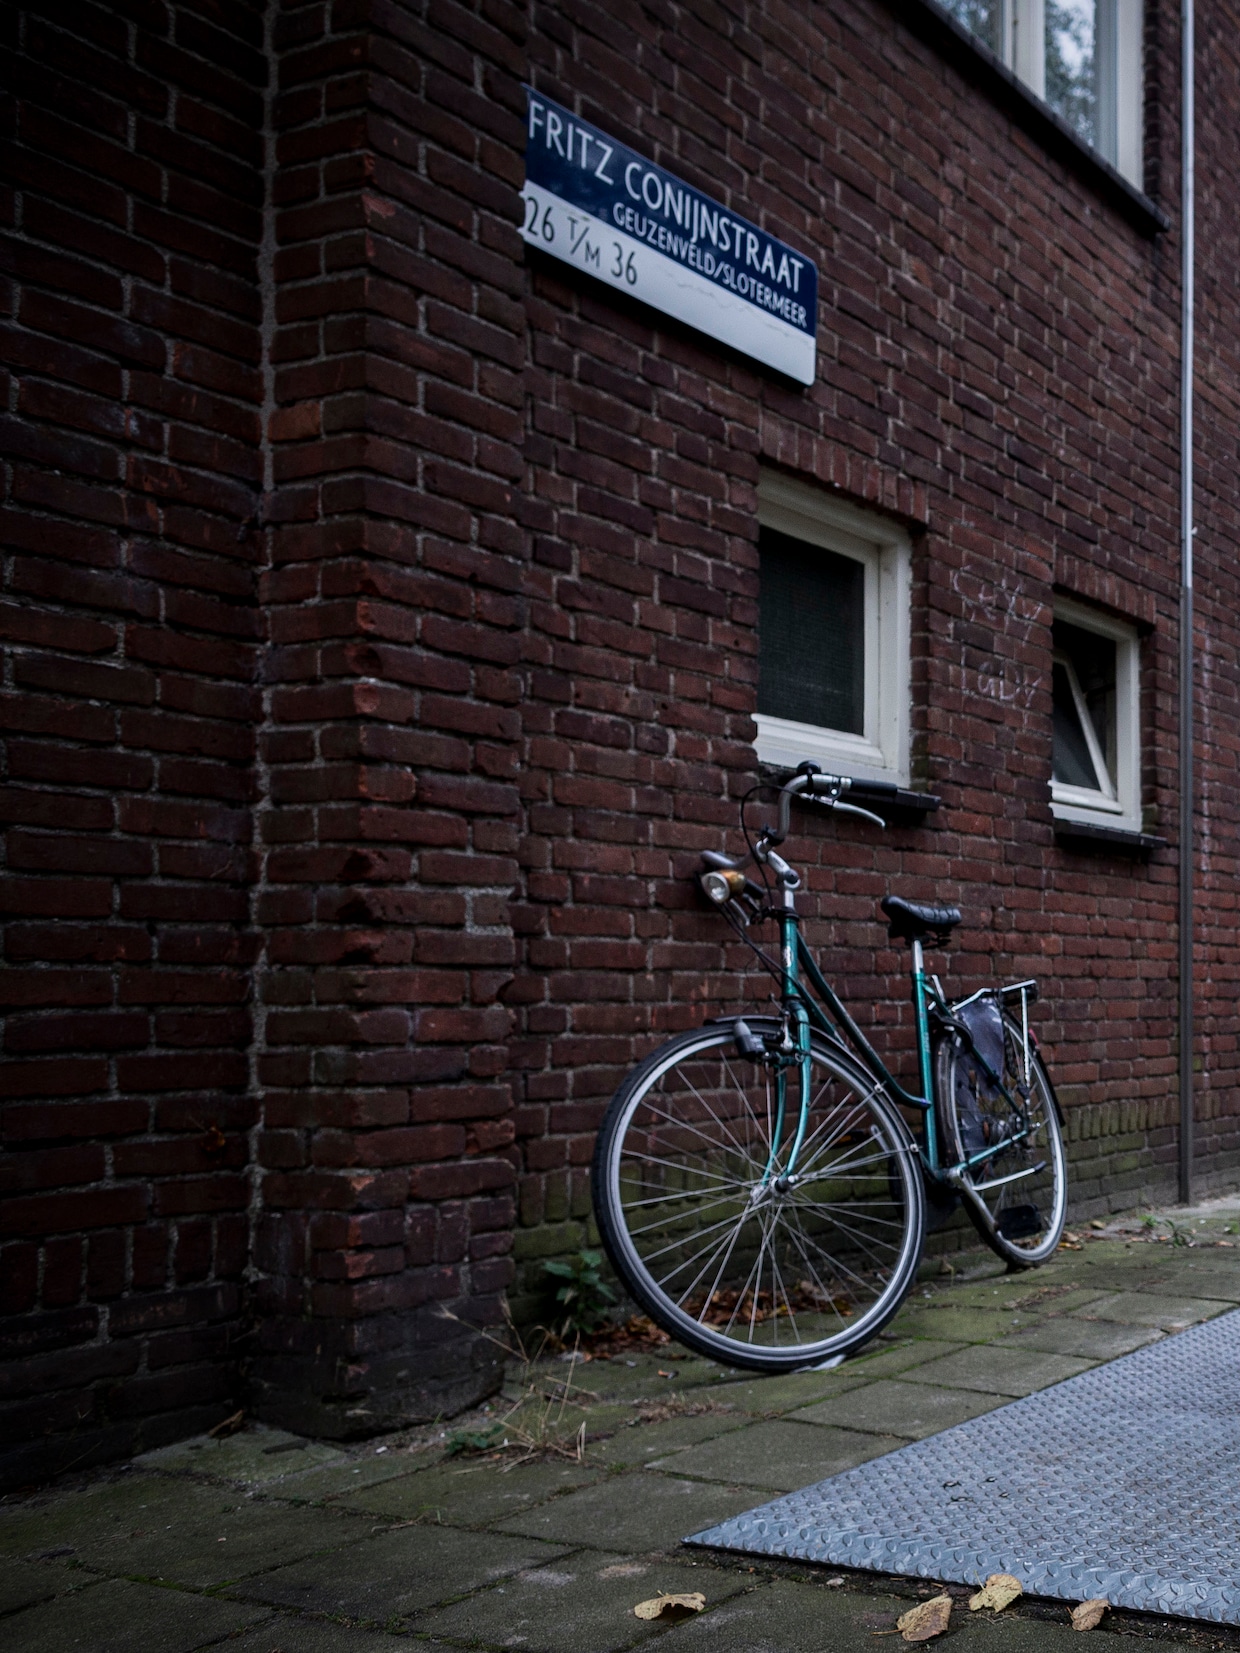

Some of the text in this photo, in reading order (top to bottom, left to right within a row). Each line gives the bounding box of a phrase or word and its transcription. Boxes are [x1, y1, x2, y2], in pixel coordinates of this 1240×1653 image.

[526, 196, 638, 286] 26 T/M 36
[528, 99, 804, 294] FRITZ CONIJNSTRAAT
[612, 201, 808, 328] GEUZENVELD/SLOTERMEER
